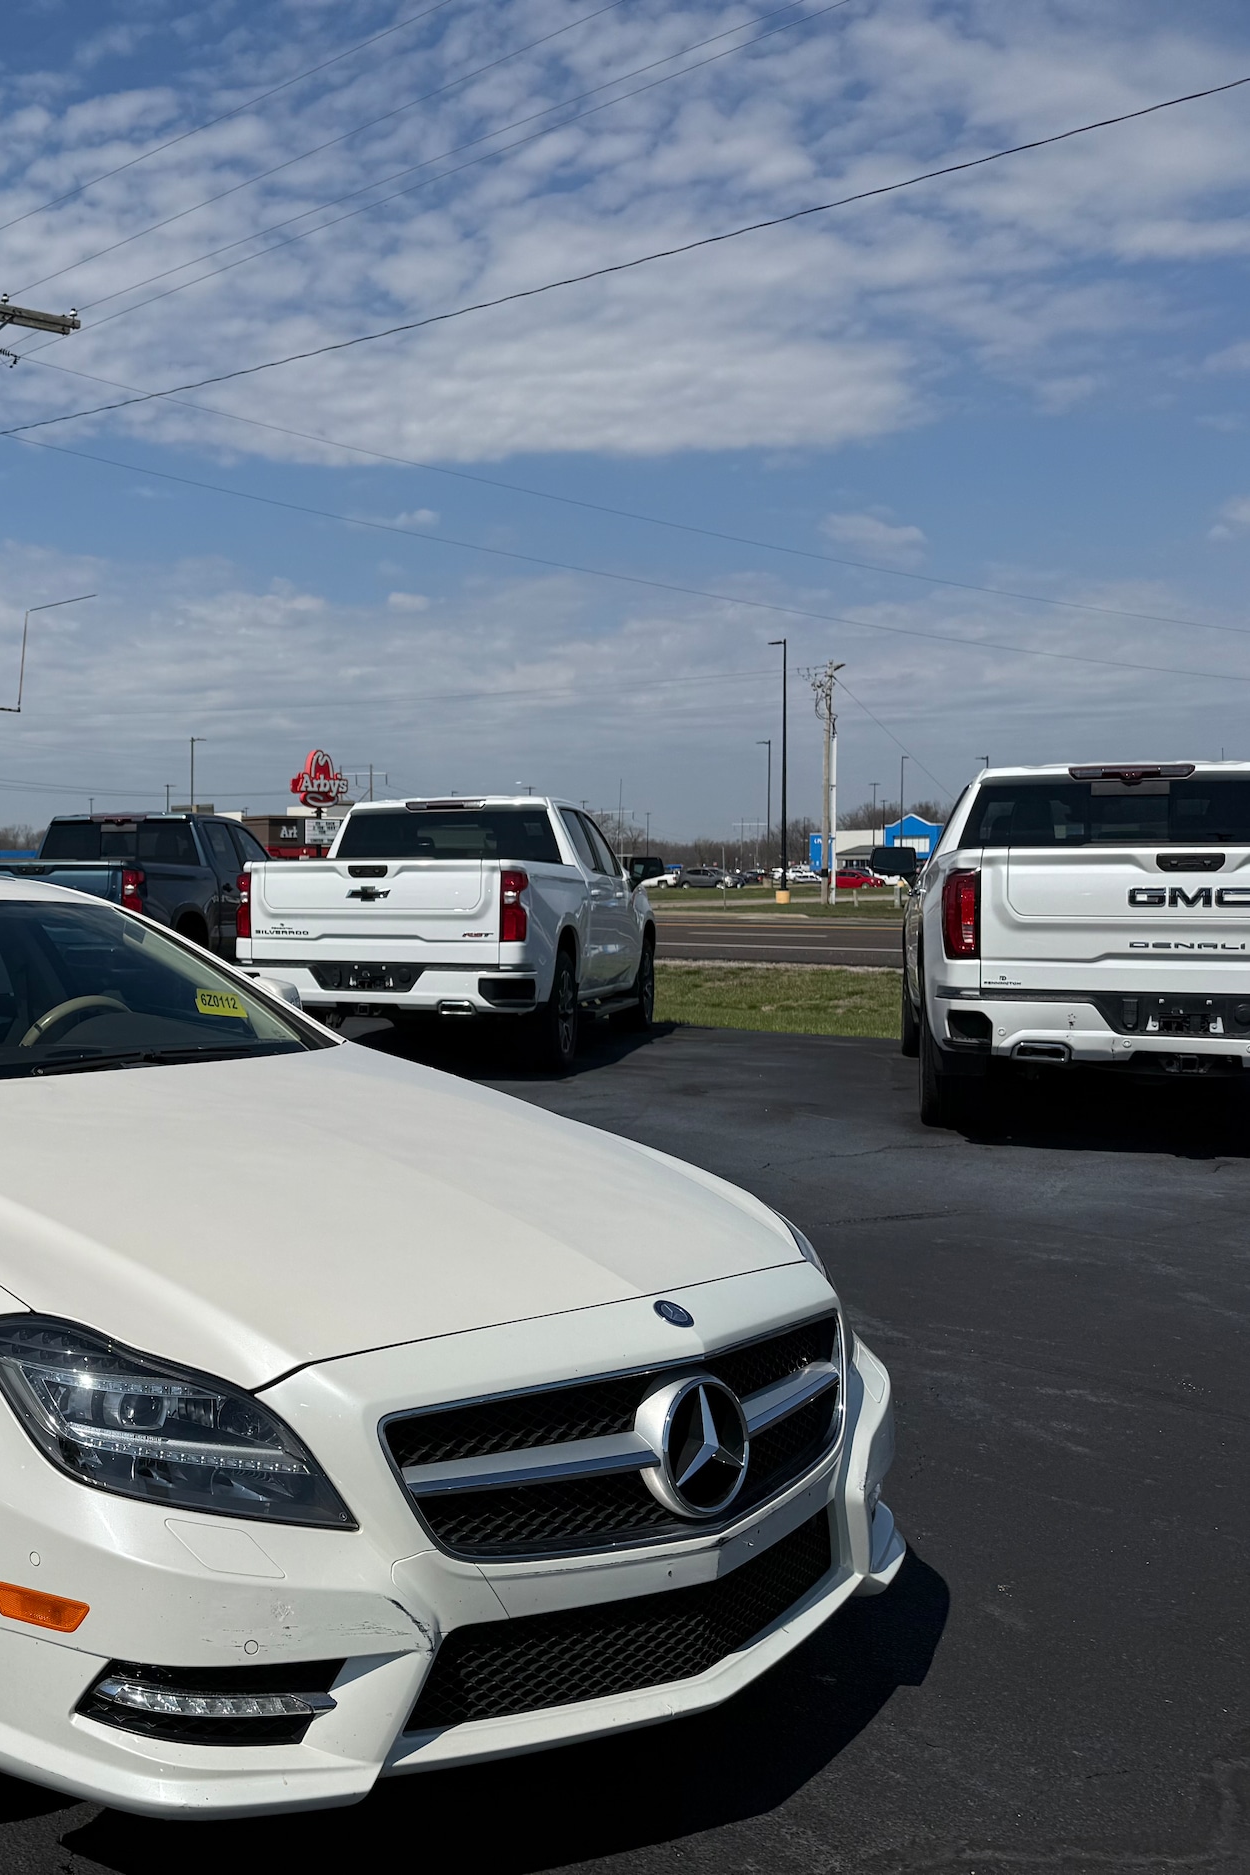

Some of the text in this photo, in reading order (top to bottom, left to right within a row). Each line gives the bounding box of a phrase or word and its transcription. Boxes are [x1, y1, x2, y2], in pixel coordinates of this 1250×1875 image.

[300, 773, 348, 797] Arby's
[1128, 887, 1250, 908] GMC
[1129, 941, 1246, 950] DENALI
[200, 993, 238, 1010] 6Z0112
